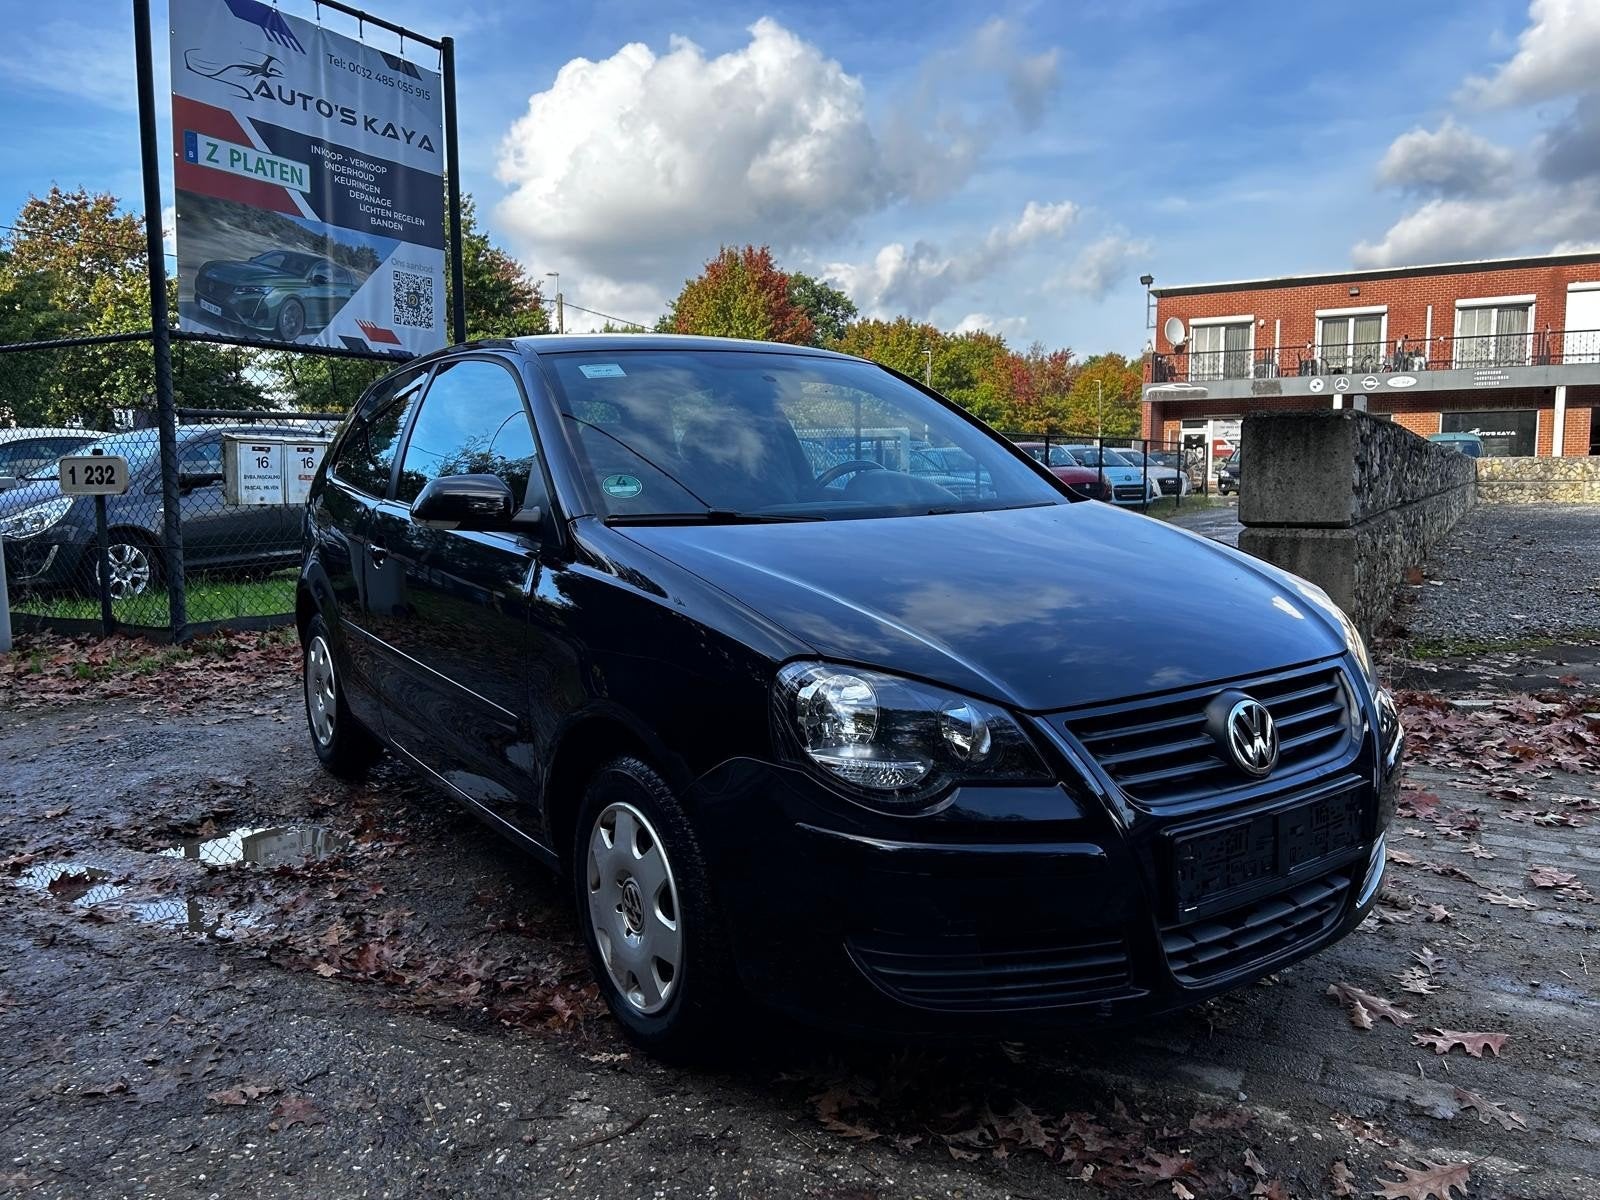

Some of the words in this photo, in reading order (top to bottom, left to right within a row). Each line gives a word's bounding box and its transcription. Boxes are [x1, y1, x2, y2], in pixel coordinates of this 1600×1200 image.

[327, 53, 346, 70] Tel:
[349, 62, 373, 80] 0032
[375, 72, 394, 87] 485
[397, 80, 414, 95] 055
[415, 87, 431, 101] 915
[253, 79, 358, 126] AUTO'S
[363, 115, 436, 154] KAYA
[206, 141, 219, 163] Z
[229, 148, 303, 186] PLATEN
[311, 144, 343, 160] INKOOP
[350, 157, 388, 175] VERKOOP
[324, 160, 375, 182] ONDERHOUD
[334, 174, 381, 194] KEURINGEN
[349, 189, 392, 208] DEPANAGE
[359, 203, 392, 218] LICHTEN
[394, 211, 425, 227] REGELEN
[370, 217, 403, 231] BANDEN
[255, 456, 269, 469] 16
[301, 457, 314, 469] 16
[68, 465, 76, 485] 1
[84, 465, 115, 485] 232
